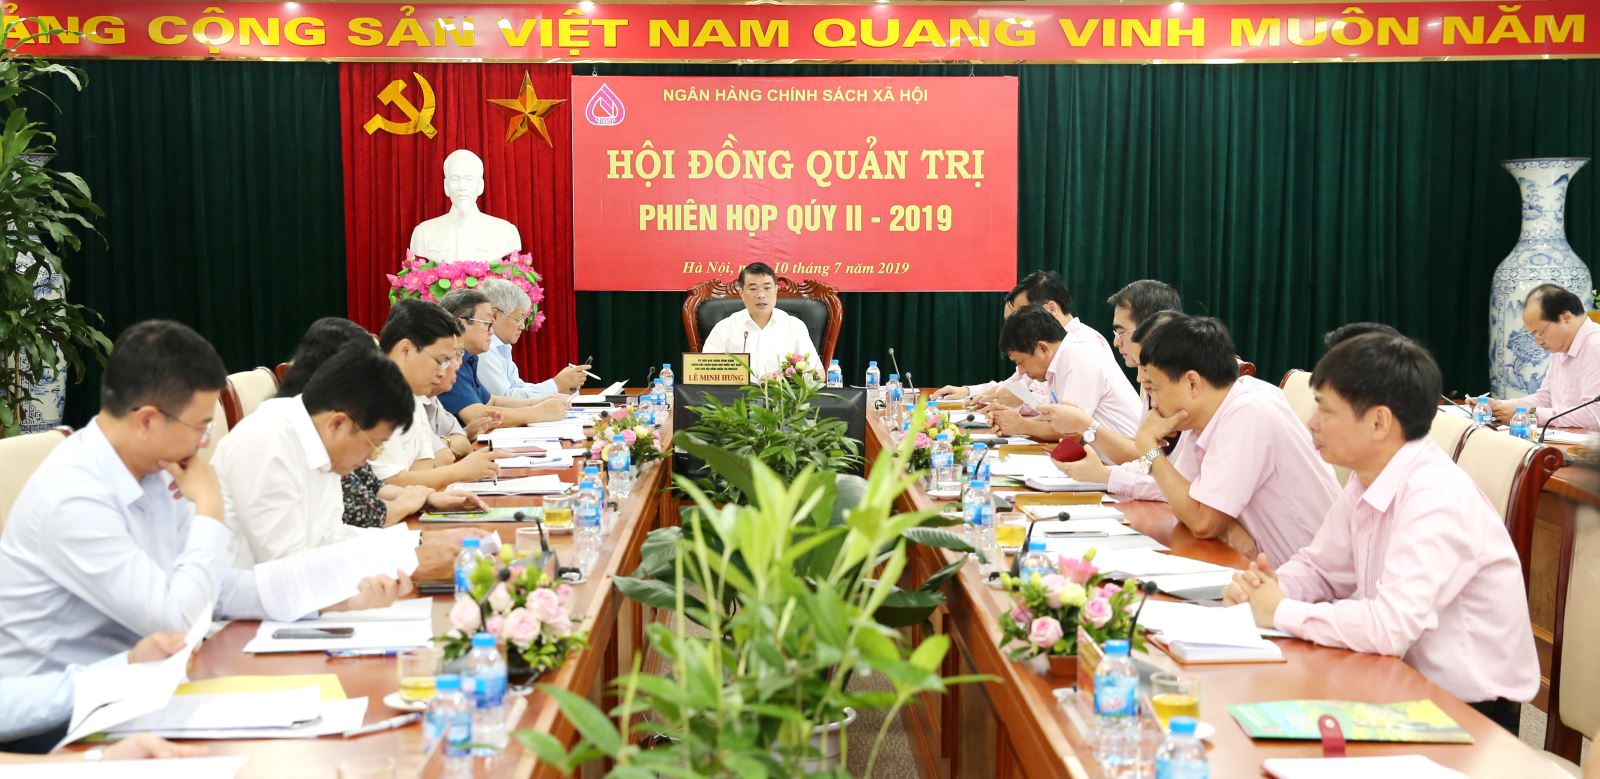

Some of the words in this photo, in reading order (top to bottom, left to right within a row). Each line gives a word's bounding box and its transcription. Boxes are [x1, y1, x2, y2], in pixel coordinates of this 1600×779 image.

[0, 2, 126, 44] ẢNG
[148, 6, 326, 54] CỘNG
[347, 6, 476, 47] SẢN
[497, 8, 629, 56] VIỆT
[649, 18, 789, 48] NAM
[813, 18, 1036, 48] QUANG
[1058, 17, 1206, 47] VINH
[1230, 7, 1420, 47] MUÔN
[1442, 4, 1585, 44] NĂM
[663, 86, 710, 102] NGÂN
[715, 85, 762, 102] HÀNG
[767, 86, 818, 102] CHÍNH
[823, 86, 868, 102] SÁCH
[873, 86, 896, 102] XÃ
[900, 85, 928, 105] HỘI
[607, 139, 675, 188] HỘI
[687, 133, 795, 180] ĐỒNG
[806, 136, 909, 187] QUẢN
[920, 149, 985, 188] TRỊ
[639, 199, 718, 231] PHIÊN
[726, 204, 778, 237] HỌP
[786, 199, 837, 235] QÚY
[846, 204, 862, 232] II
[889, 204, 953, 232] 2019
[682, 261, 703, 274] Hà
[706, 261, 734, 276] Nội,
[773, 262, 789, 274] 10
[792, 261, 830, 276] tháng
[834, 262, 843, 274] 7
[845, 262, 874, 274] năm
[877, 262, 910, 274] 2019
[688, 373, 699, 381] LÊ
